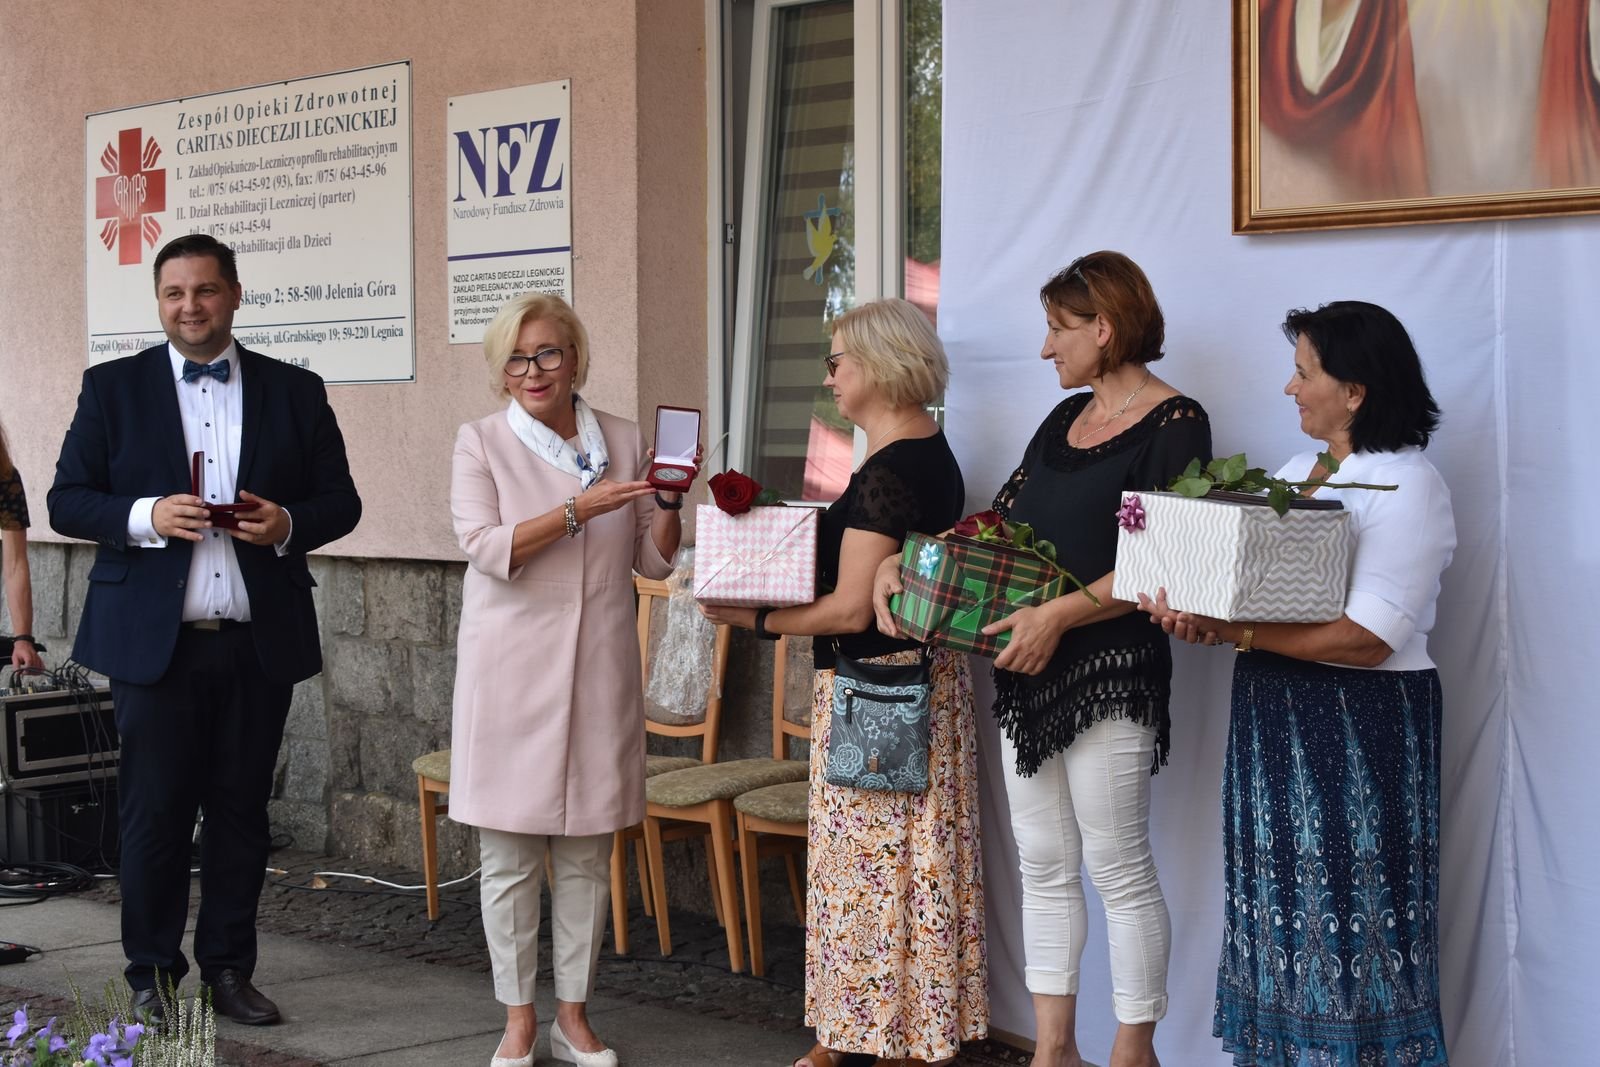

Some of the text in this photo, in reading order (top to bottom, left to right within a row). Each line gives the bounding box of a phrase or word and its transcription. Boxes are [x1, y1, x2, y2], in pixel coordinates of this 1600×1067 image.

[178, 79, 397, 131] Zespół Opieki Zdrowotnej
[176, 107, 397, 156] CARITAS DIECEZJI LEGNICKIEJ
[176, 167, 183, 181] I.
[329, 141, 398, 161] rehabilitacyjnym
[453, 117, 564, 203] NFZ
[229, 176, 271, 193] 643-45-92
[295, 173, 313, 186] fax:
[340, 162, 387, 181] 643-45-96
[176, 207, 186, 220] II.
[213, 198, 267, 216] Rehabilitacji
[270, 192, 316, 211] Leczniczej
[319, 188, 356, 209] (parter)
[453, 195, 564, 220] Narodowy Fundusz Zdrowia
[229, 218, 271, 234] 643-45-94
[230, 232, 332, 254] Rehabilitacji dla Dzieci
[470, 271, 497, 282] CARITAS
[497, 269, 526, 280] DIECEZJI
[526, 267, 565, 278] LEGNICKIEJ
[240, 289, 272, 309] skiego
[287, 285, 323, 302] 58-500
[325, 282, 364, 300] Jelenia
[367, 280, 397, 298] Góra
[342, 326, 369, 341] 59-220
[371, 324, 404, 342] Legnica
